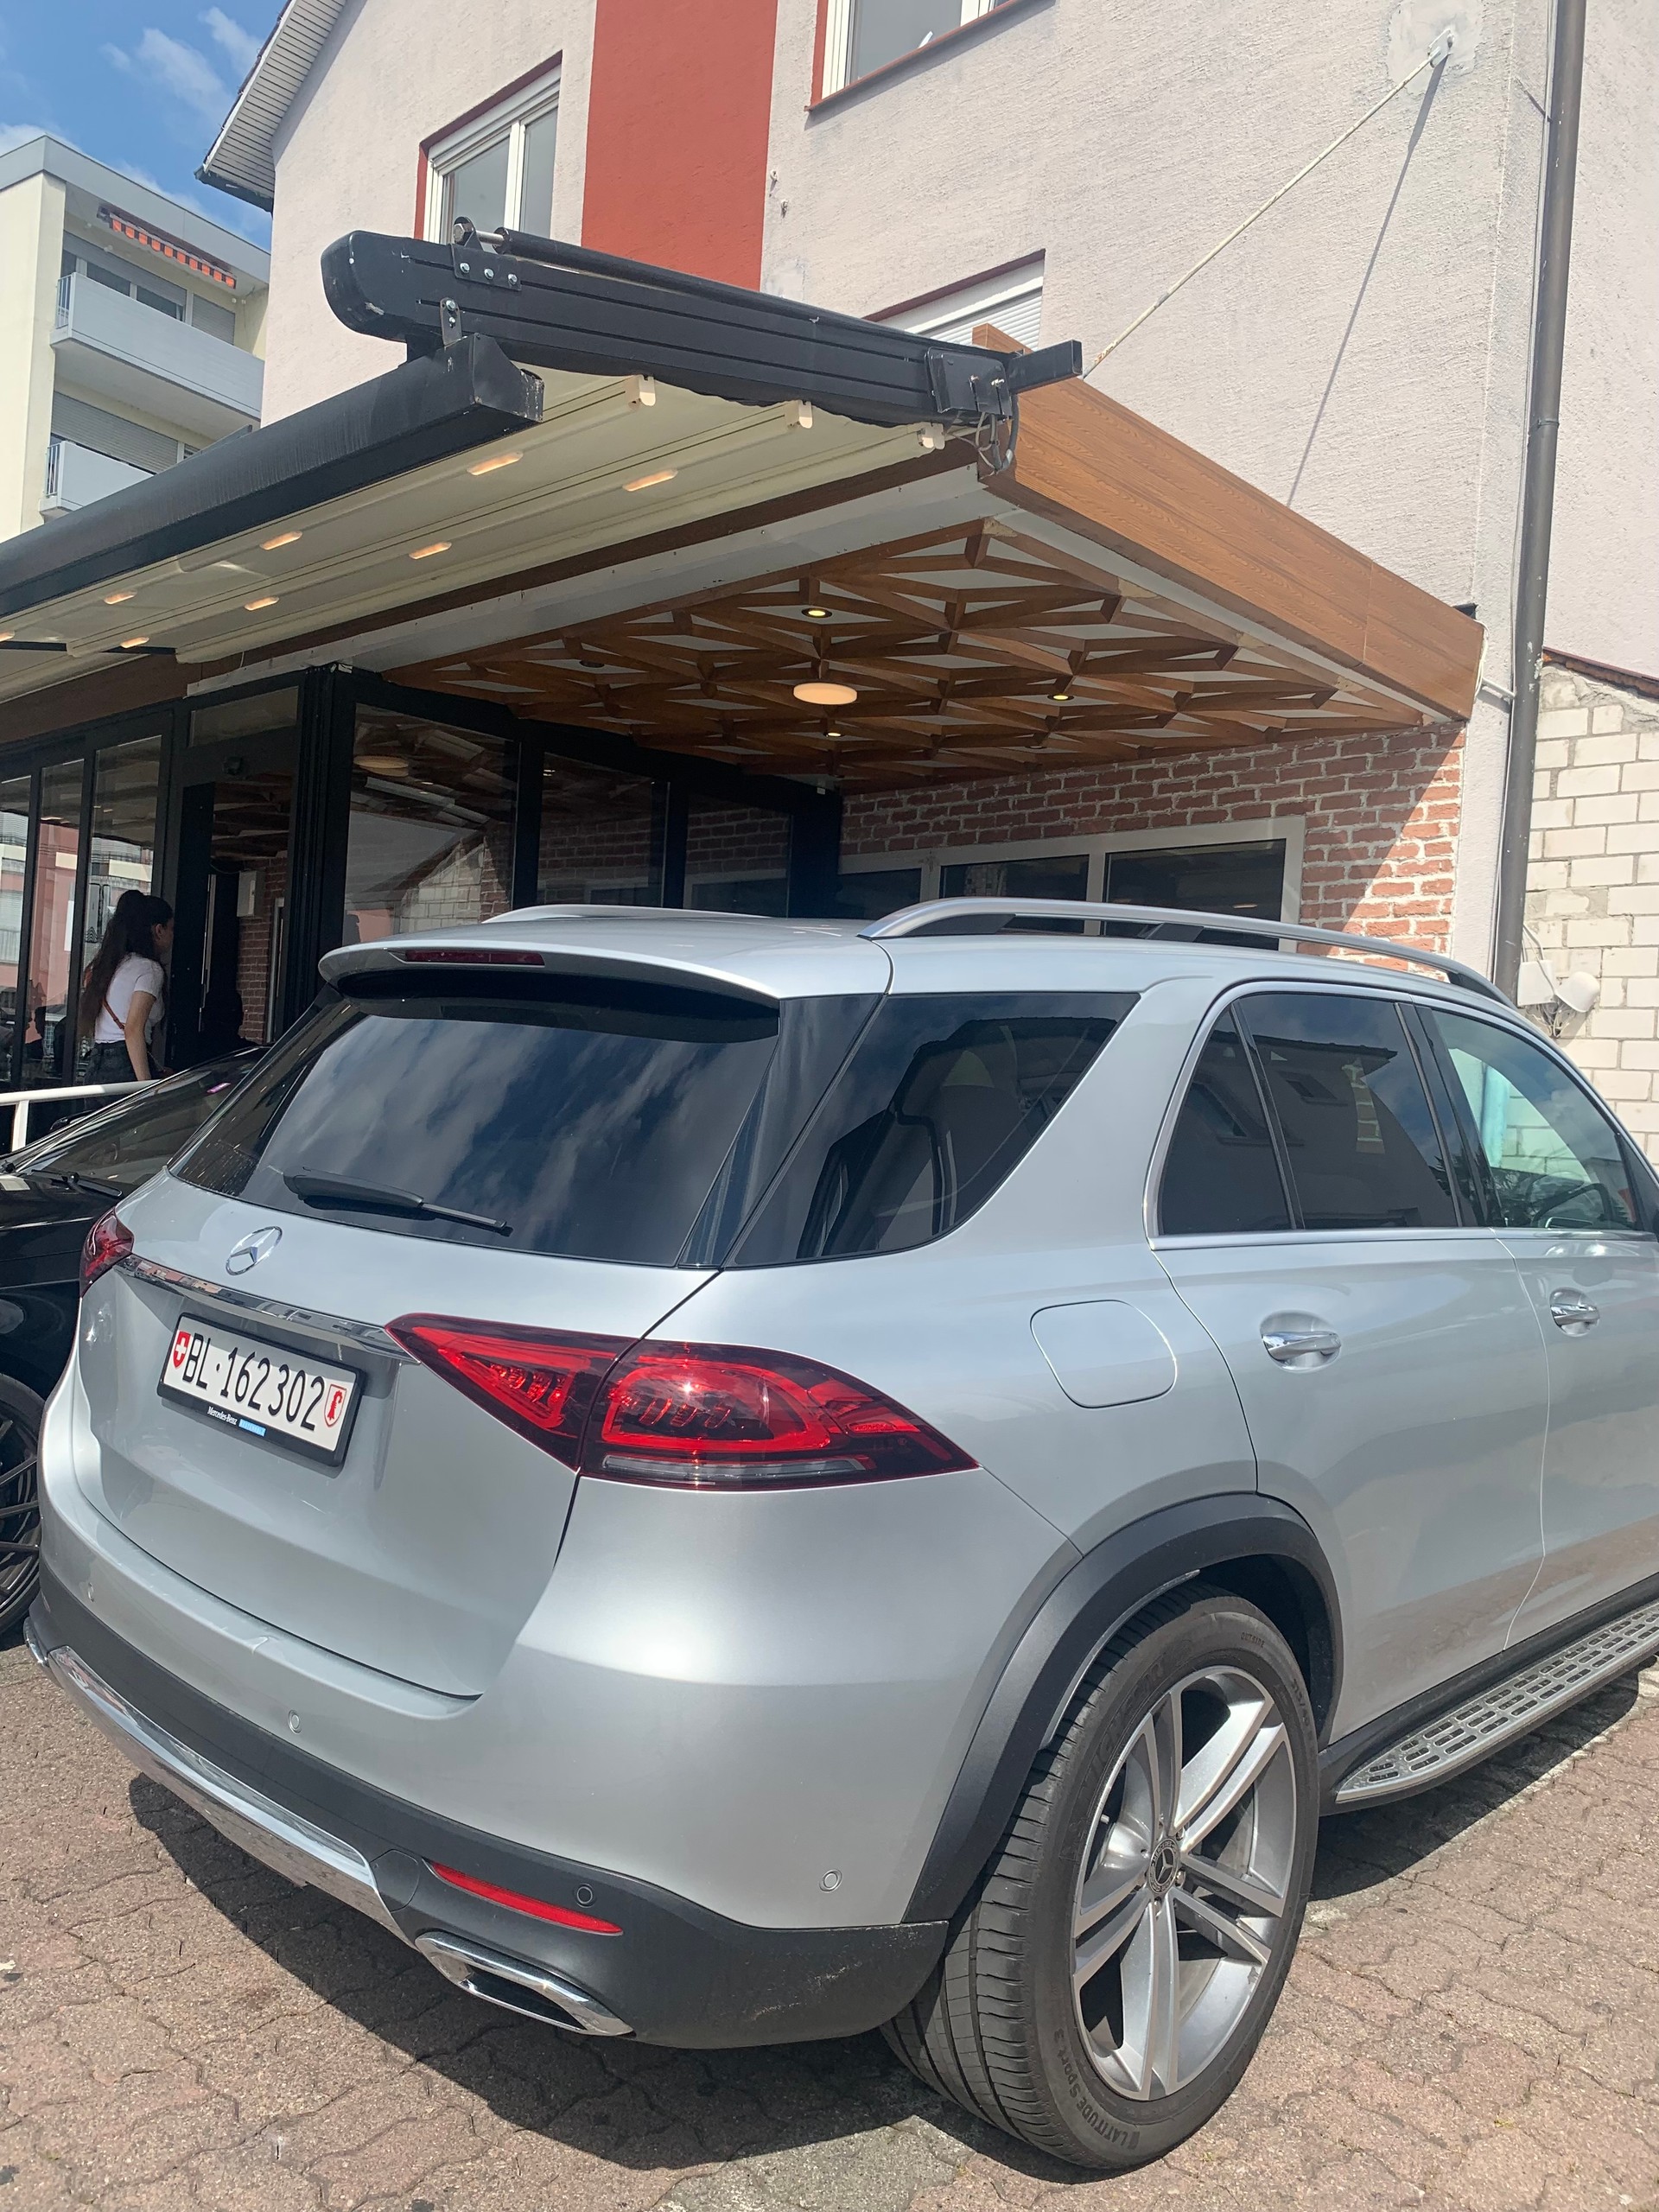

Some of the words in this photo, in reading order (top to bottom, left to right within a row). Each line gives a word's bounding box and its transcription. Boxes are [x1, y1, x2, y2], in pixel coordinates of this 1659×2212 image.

[207, 1406, 238, 1425] Mercedes-Benz
[1241, 1631, 1265, 1649] OUTSIDE
[1053, 2028, 1065, 2041] 3
[1056, 2049, 1079, 2098] Sport
[1076, 2098, 1128, 2146] LATITUDE
